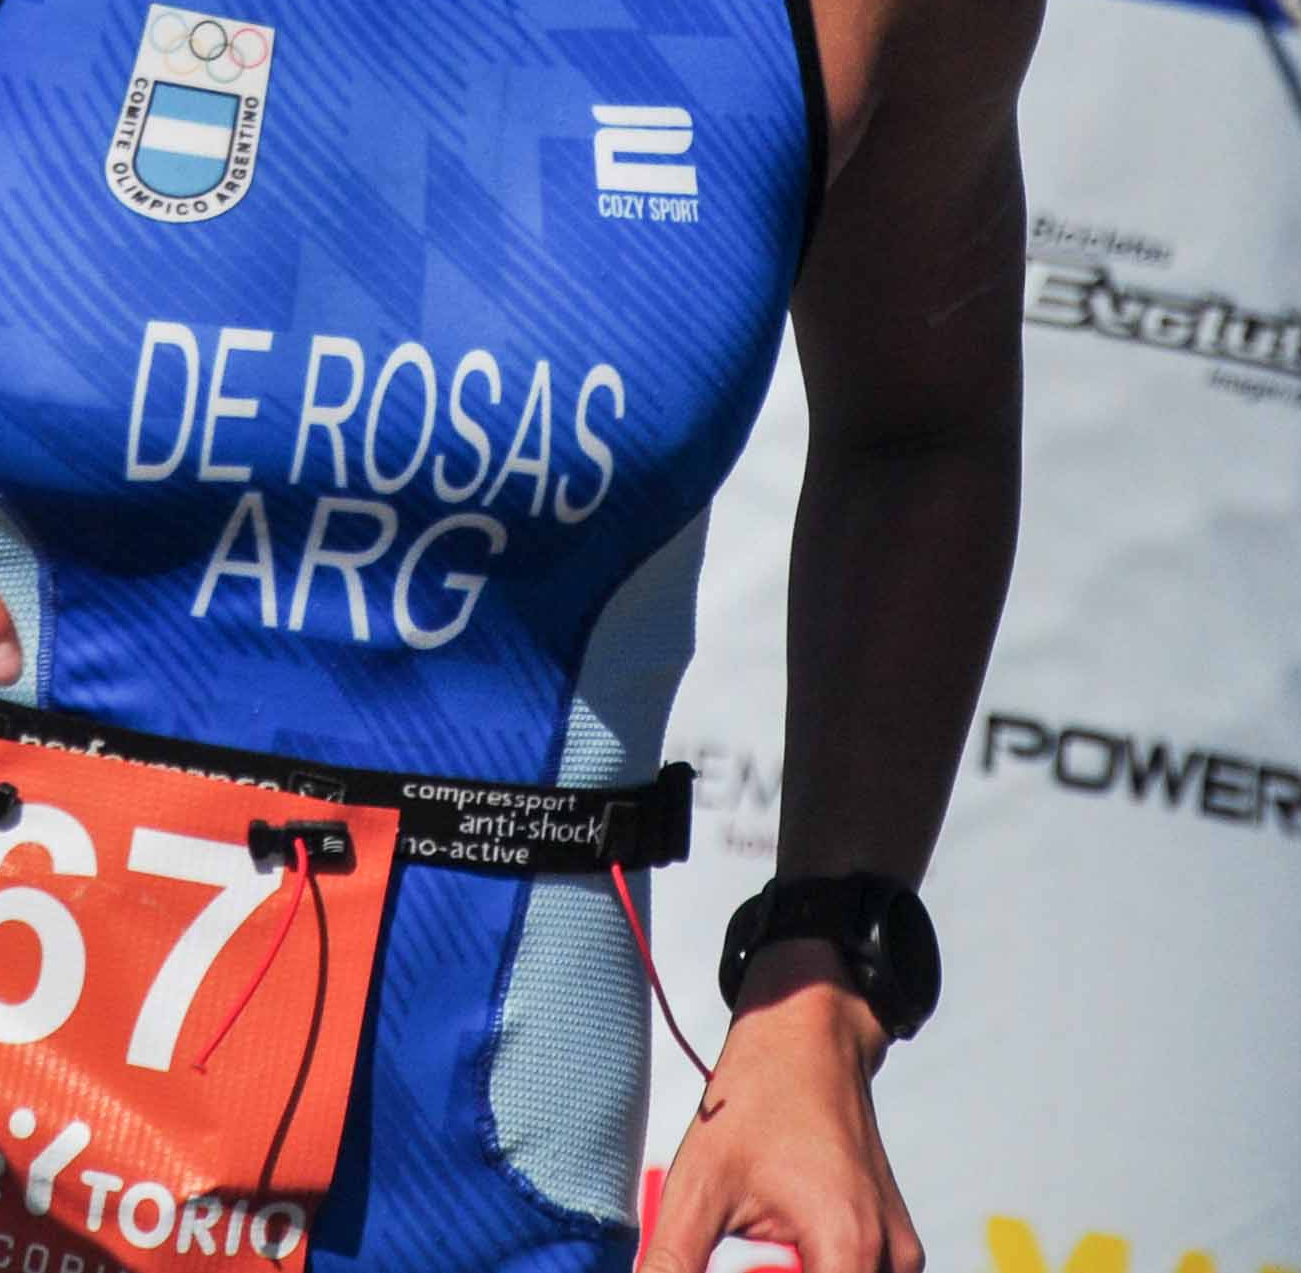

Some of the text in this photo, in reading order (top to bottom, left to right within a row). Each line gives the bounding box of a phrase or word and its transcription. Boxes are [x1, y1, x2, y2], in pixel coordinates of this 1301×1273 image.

[112, 77, 259, 217] COMITE OLIMPICO ARGENTINO
[598, 193, 699, 223] COZY SPORT
[125, 320, 627, 525] DE ROSAS
[189, 491, 509, 651] ARG
[402, 782, 578, 817] compressport
[459, 811, 603, 845] anti-shock
